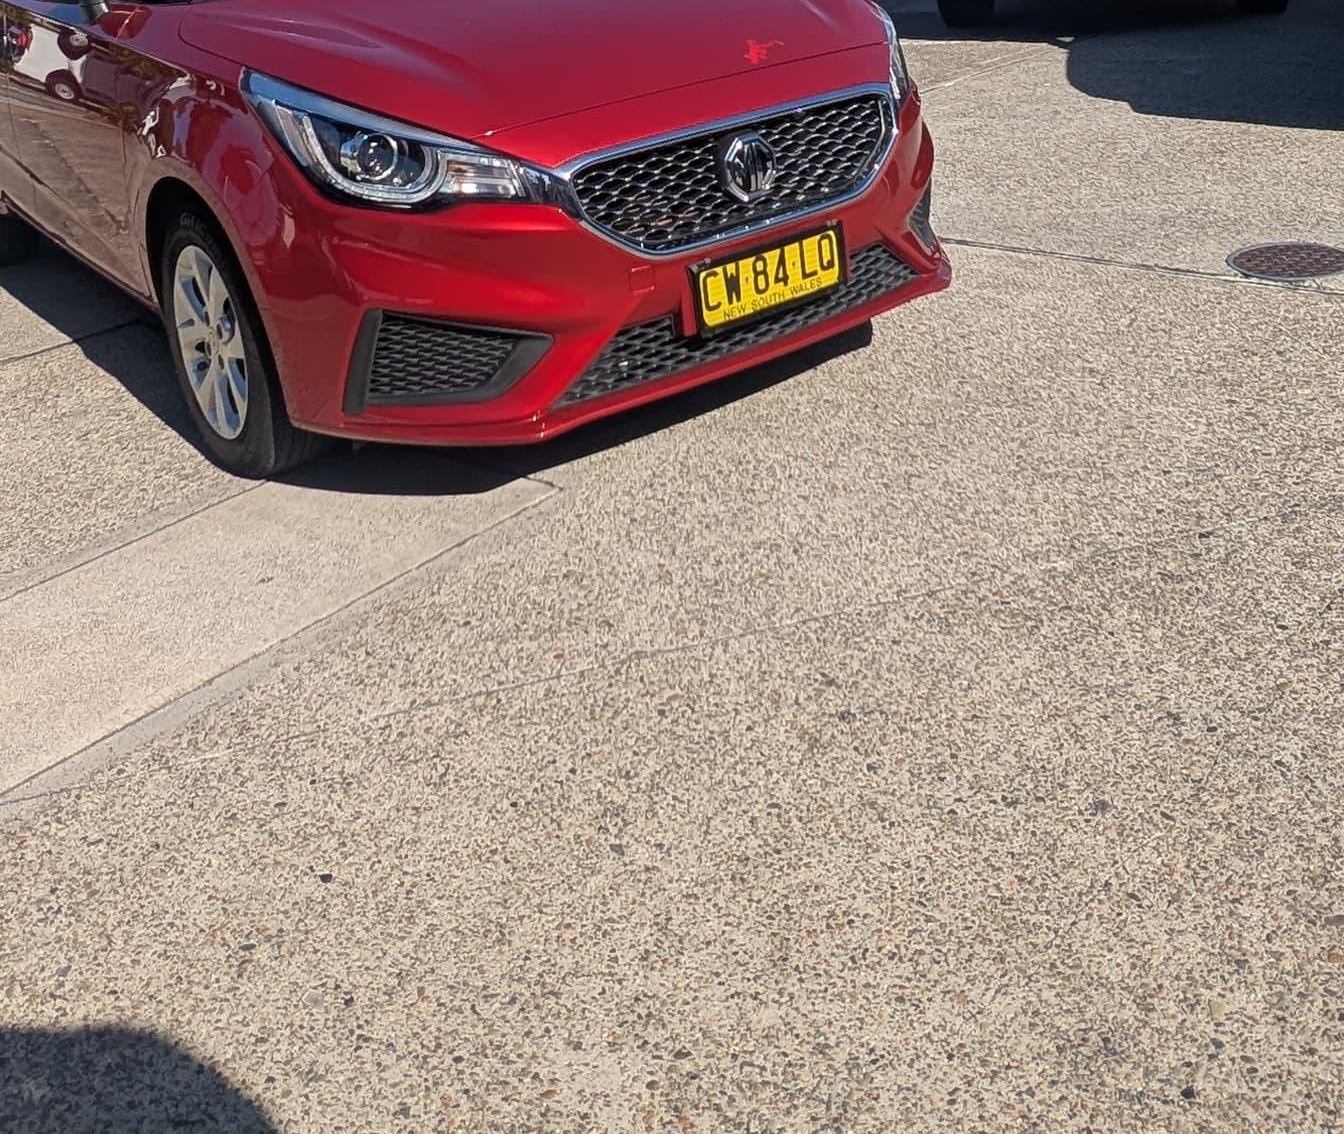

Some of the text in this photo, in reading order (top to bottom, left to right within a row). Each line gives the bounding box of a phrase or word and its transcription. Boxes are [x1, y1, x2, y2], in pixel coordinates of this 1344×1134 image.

[723, 277, 823, 320] NEW SOUTH WALES
